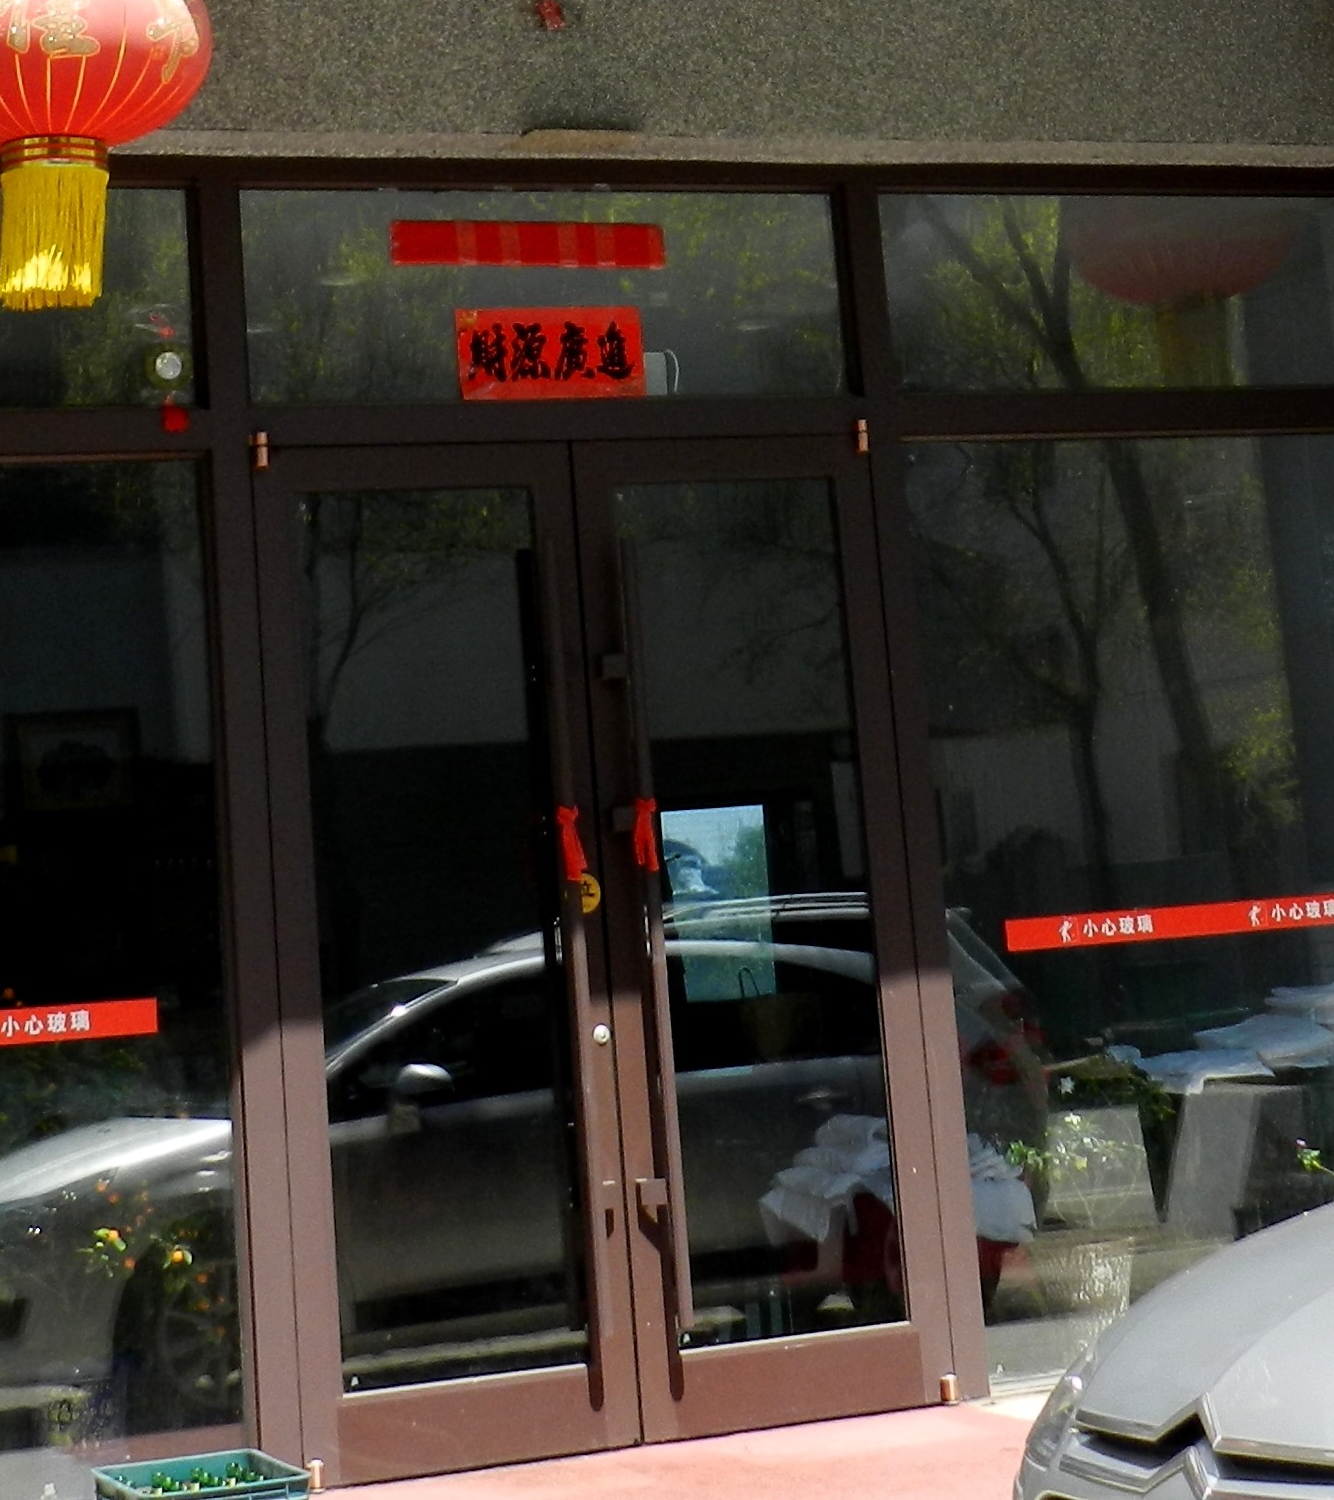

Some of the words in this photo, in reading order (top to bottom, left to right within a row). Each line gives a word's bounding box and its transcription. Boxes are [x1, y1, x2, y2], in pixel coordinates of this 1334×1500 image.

[1082, 912, 1155, 938] 小心玻璃
[0, 1009, 91, 1039] 小心玻璃
